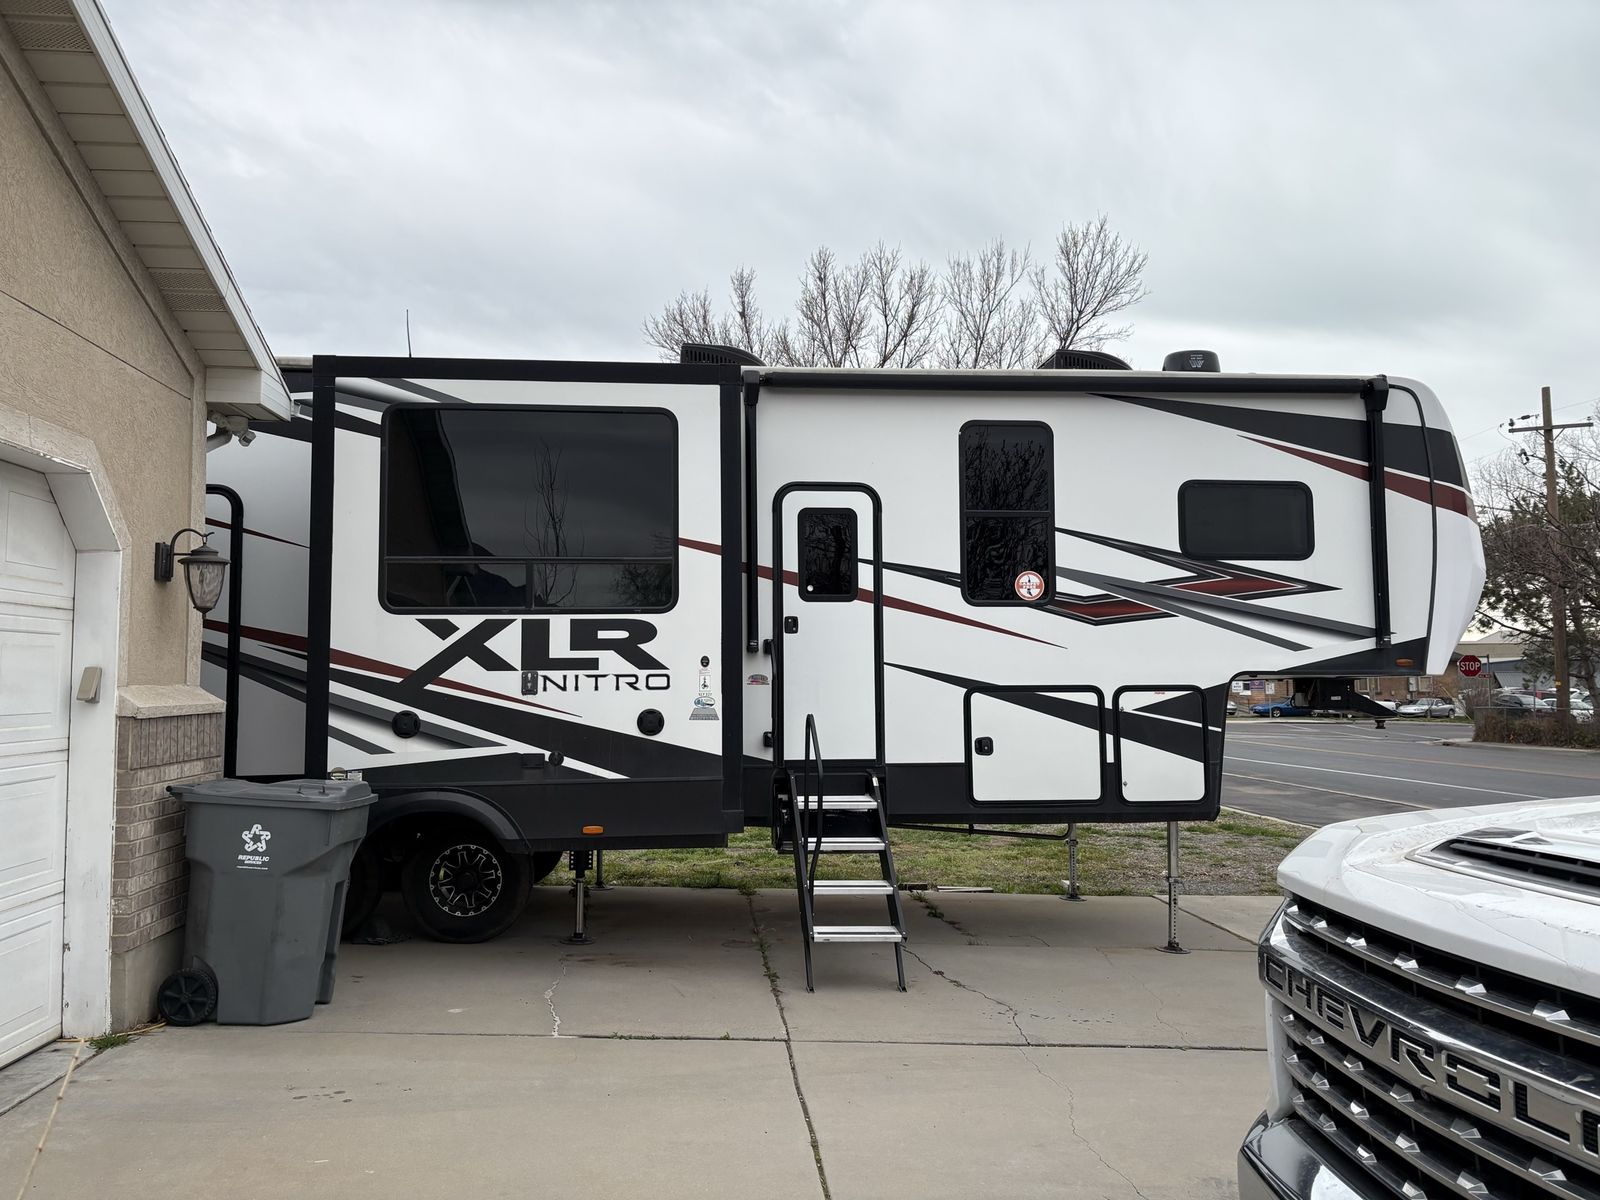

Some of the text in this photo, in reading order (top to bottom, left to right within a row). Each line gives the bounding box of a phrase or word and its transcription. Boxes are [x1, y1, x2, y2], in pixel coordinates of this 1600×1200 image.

[402, 618, 671, 686] XLR
[1460, 662, 1481, 671] STOP
[542, 673, 671, 692] NITRO
